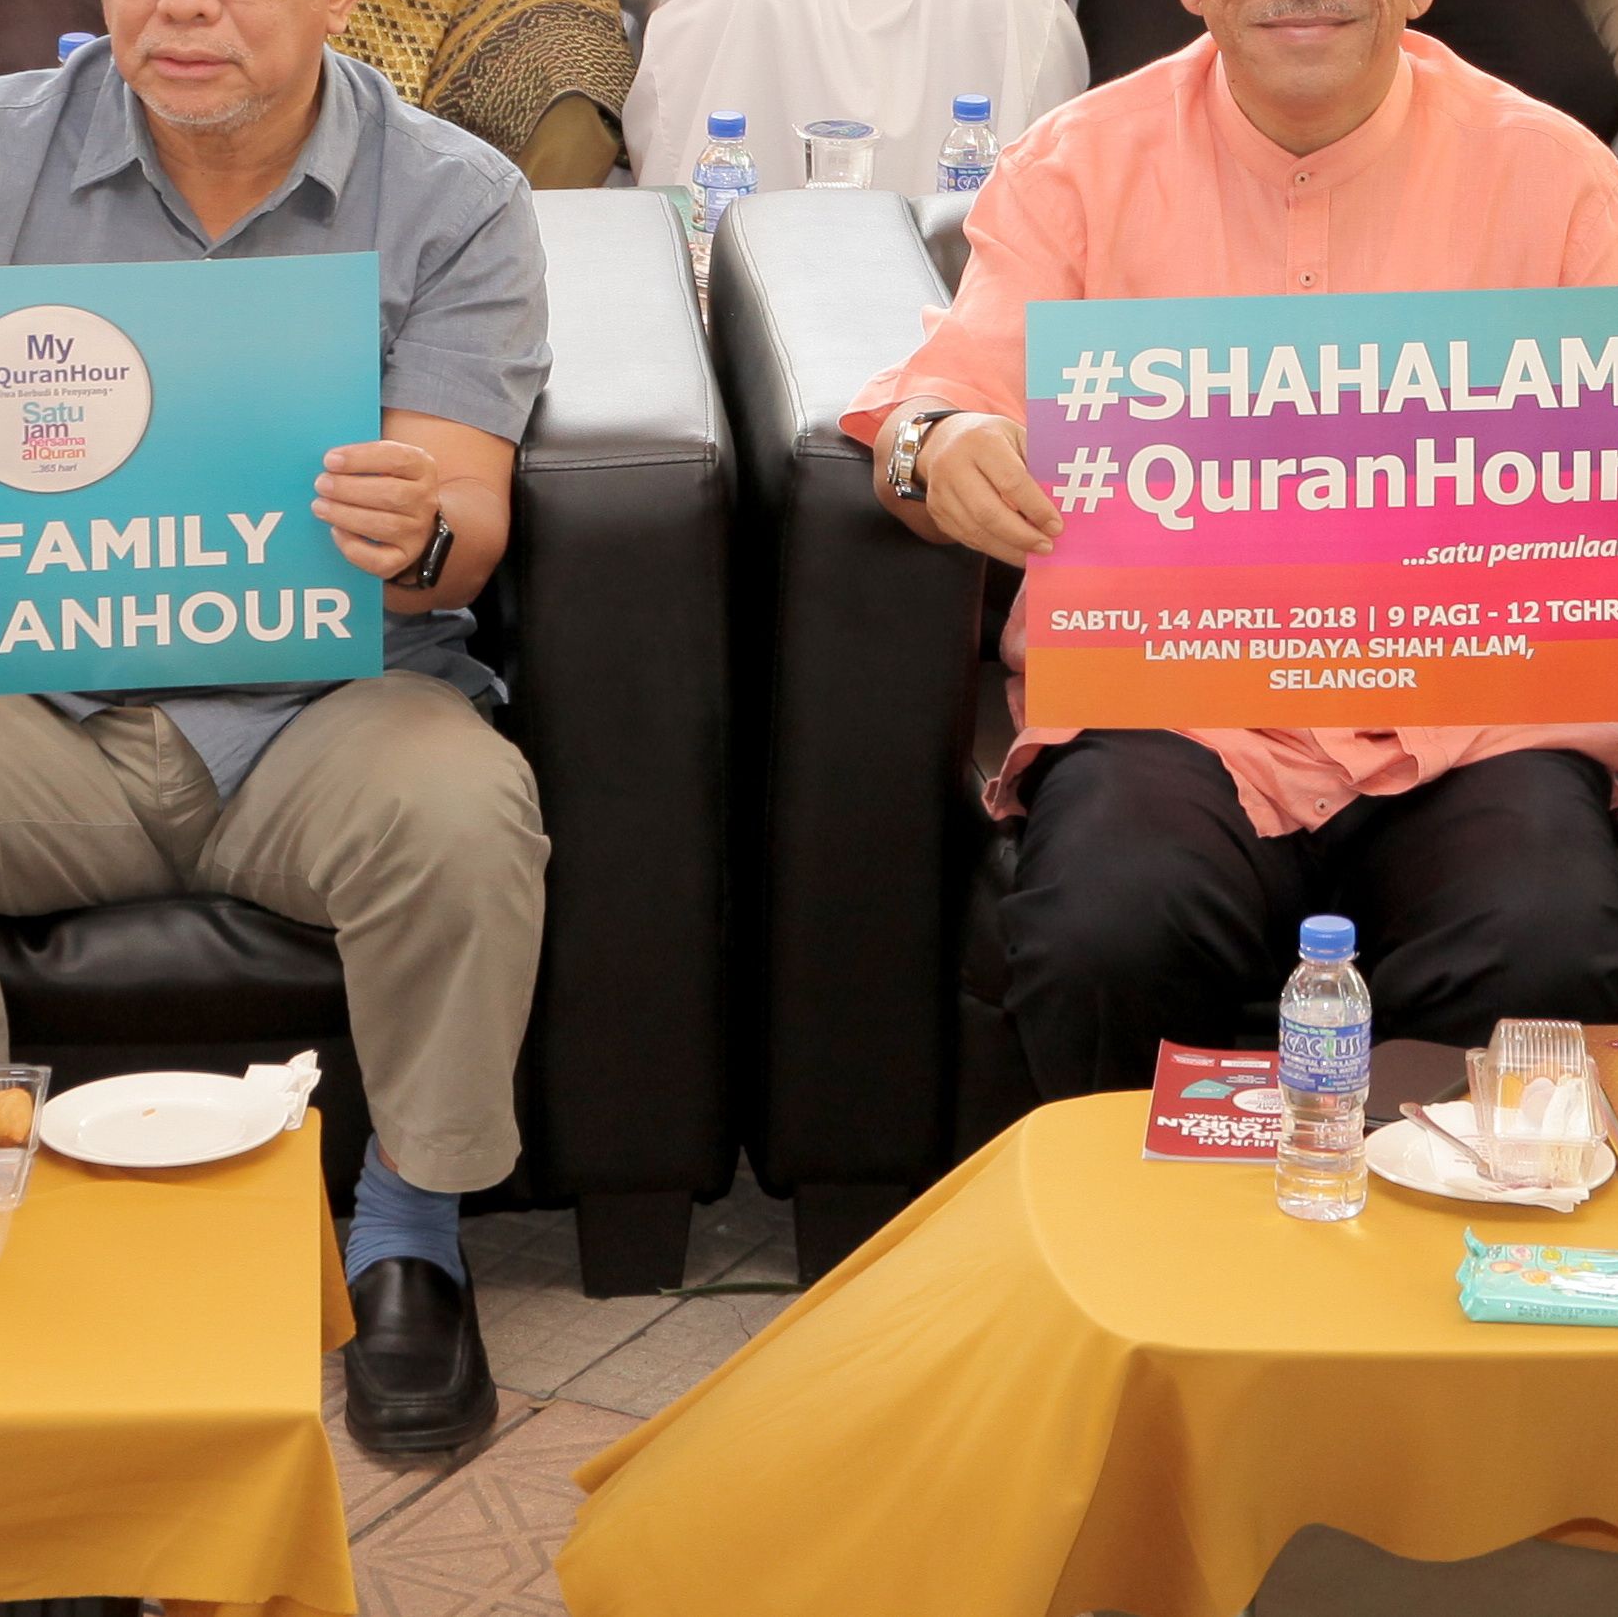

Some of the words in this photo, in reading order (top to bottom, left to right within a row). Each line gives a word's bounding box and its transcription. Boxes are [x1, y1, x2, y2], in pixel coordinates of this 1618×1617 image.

[27, 334, 74, 364] My
[22, 401, 84, 424] Satu
[22, 420, 69, 444] jam
[1050, 608, 1149, 635] SABTU,
[1156, 609, 1190, 630] 14
[1197, 608, 1283, 630] APRIL
[1289, 606, 1357, 629] 2018
[1389, 606, 1404, 628] 9
[1414, 604, 1481, 627] PAGI
[1506, 602, 1540, 624] 12
[1144, 638, 1241, 661] LAMAN
[1248, 637, 1361, 659] BUDAYA
[1367, 635, 1444, 659] SHAH
[1451, 634, 1535, 660] ALAM,
[1269, 668, 1417, 690] SELANGOR
[1198, 1137, 1275, 1148] HIJRAH
